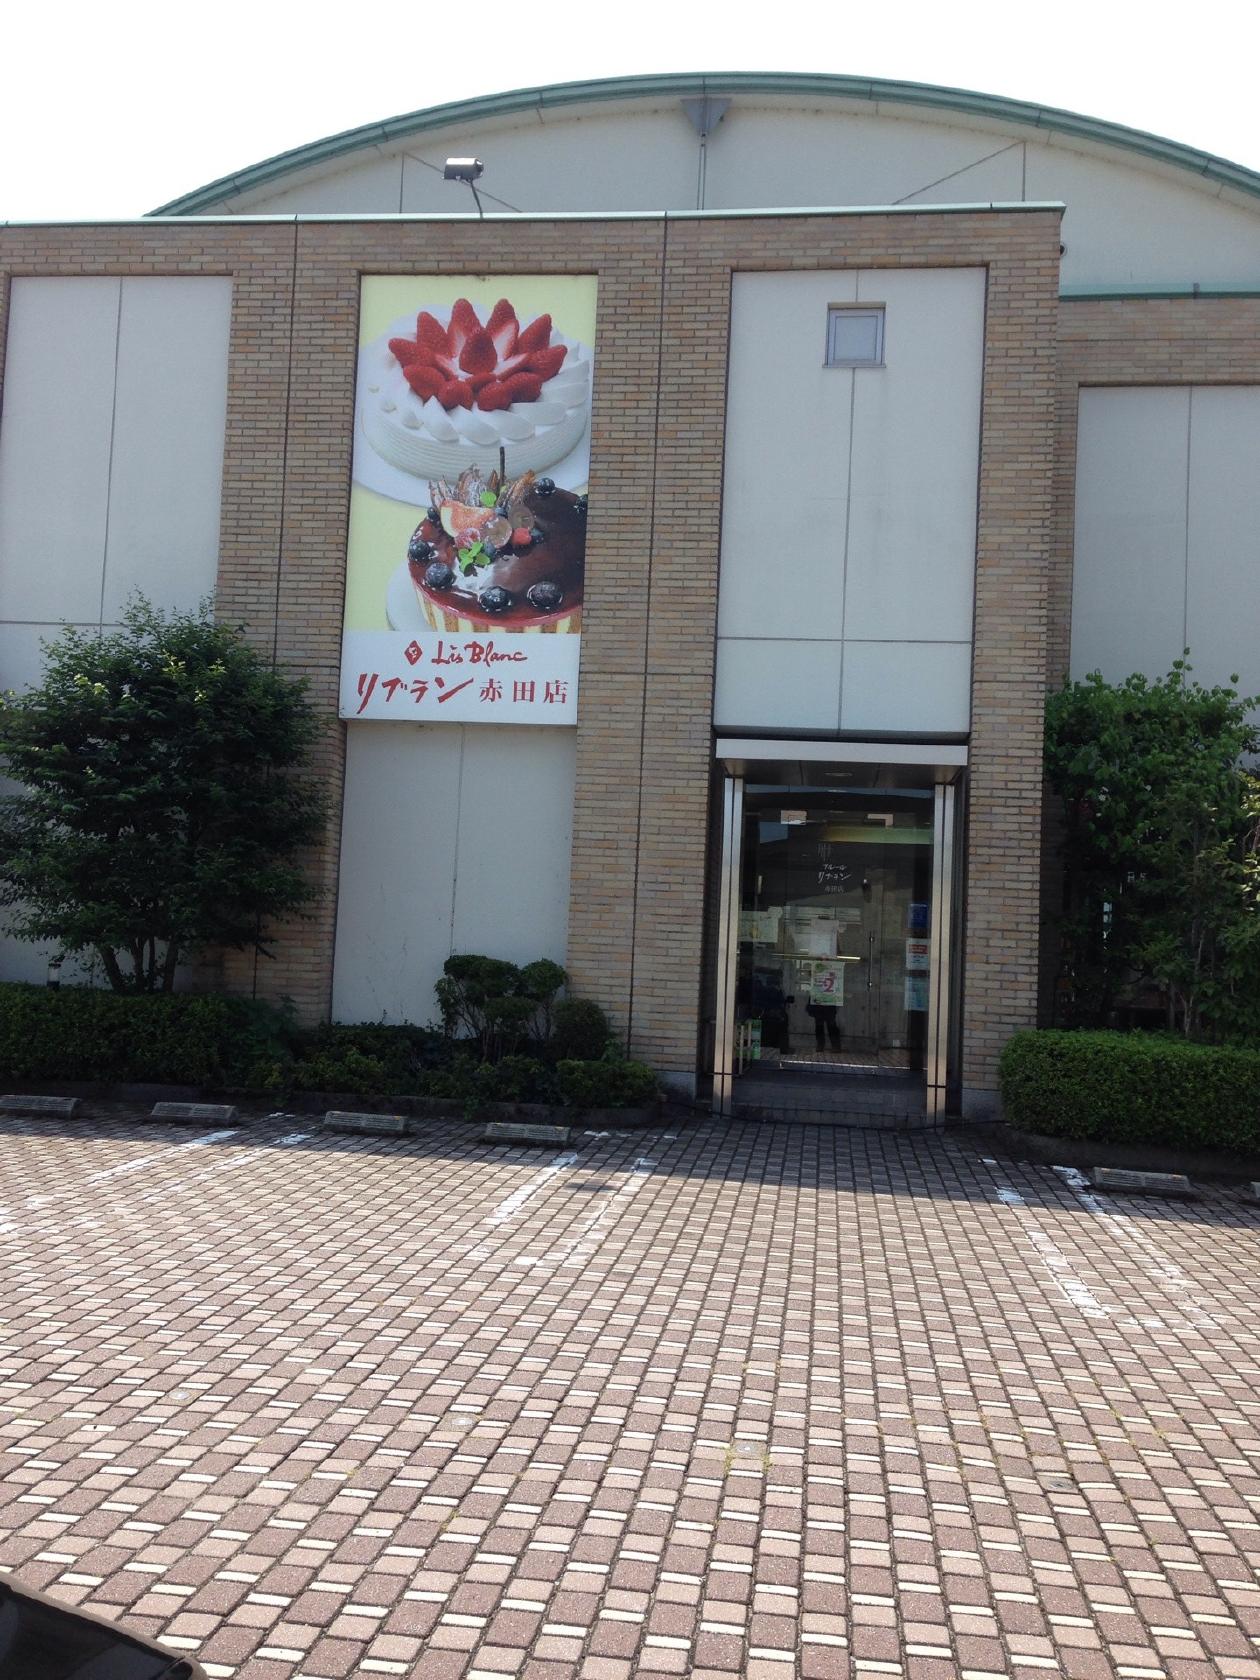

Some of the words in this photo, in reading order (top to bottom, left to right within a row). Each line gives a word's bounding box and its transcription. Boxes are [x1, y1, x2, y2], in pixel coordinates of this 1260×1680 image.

[431, 640, 464, 665] Lis
[464, 640, 528, 667] Blanc
[357, 673, 474, 715] リブラン
[479, 678, 569, 704] 赤田店
